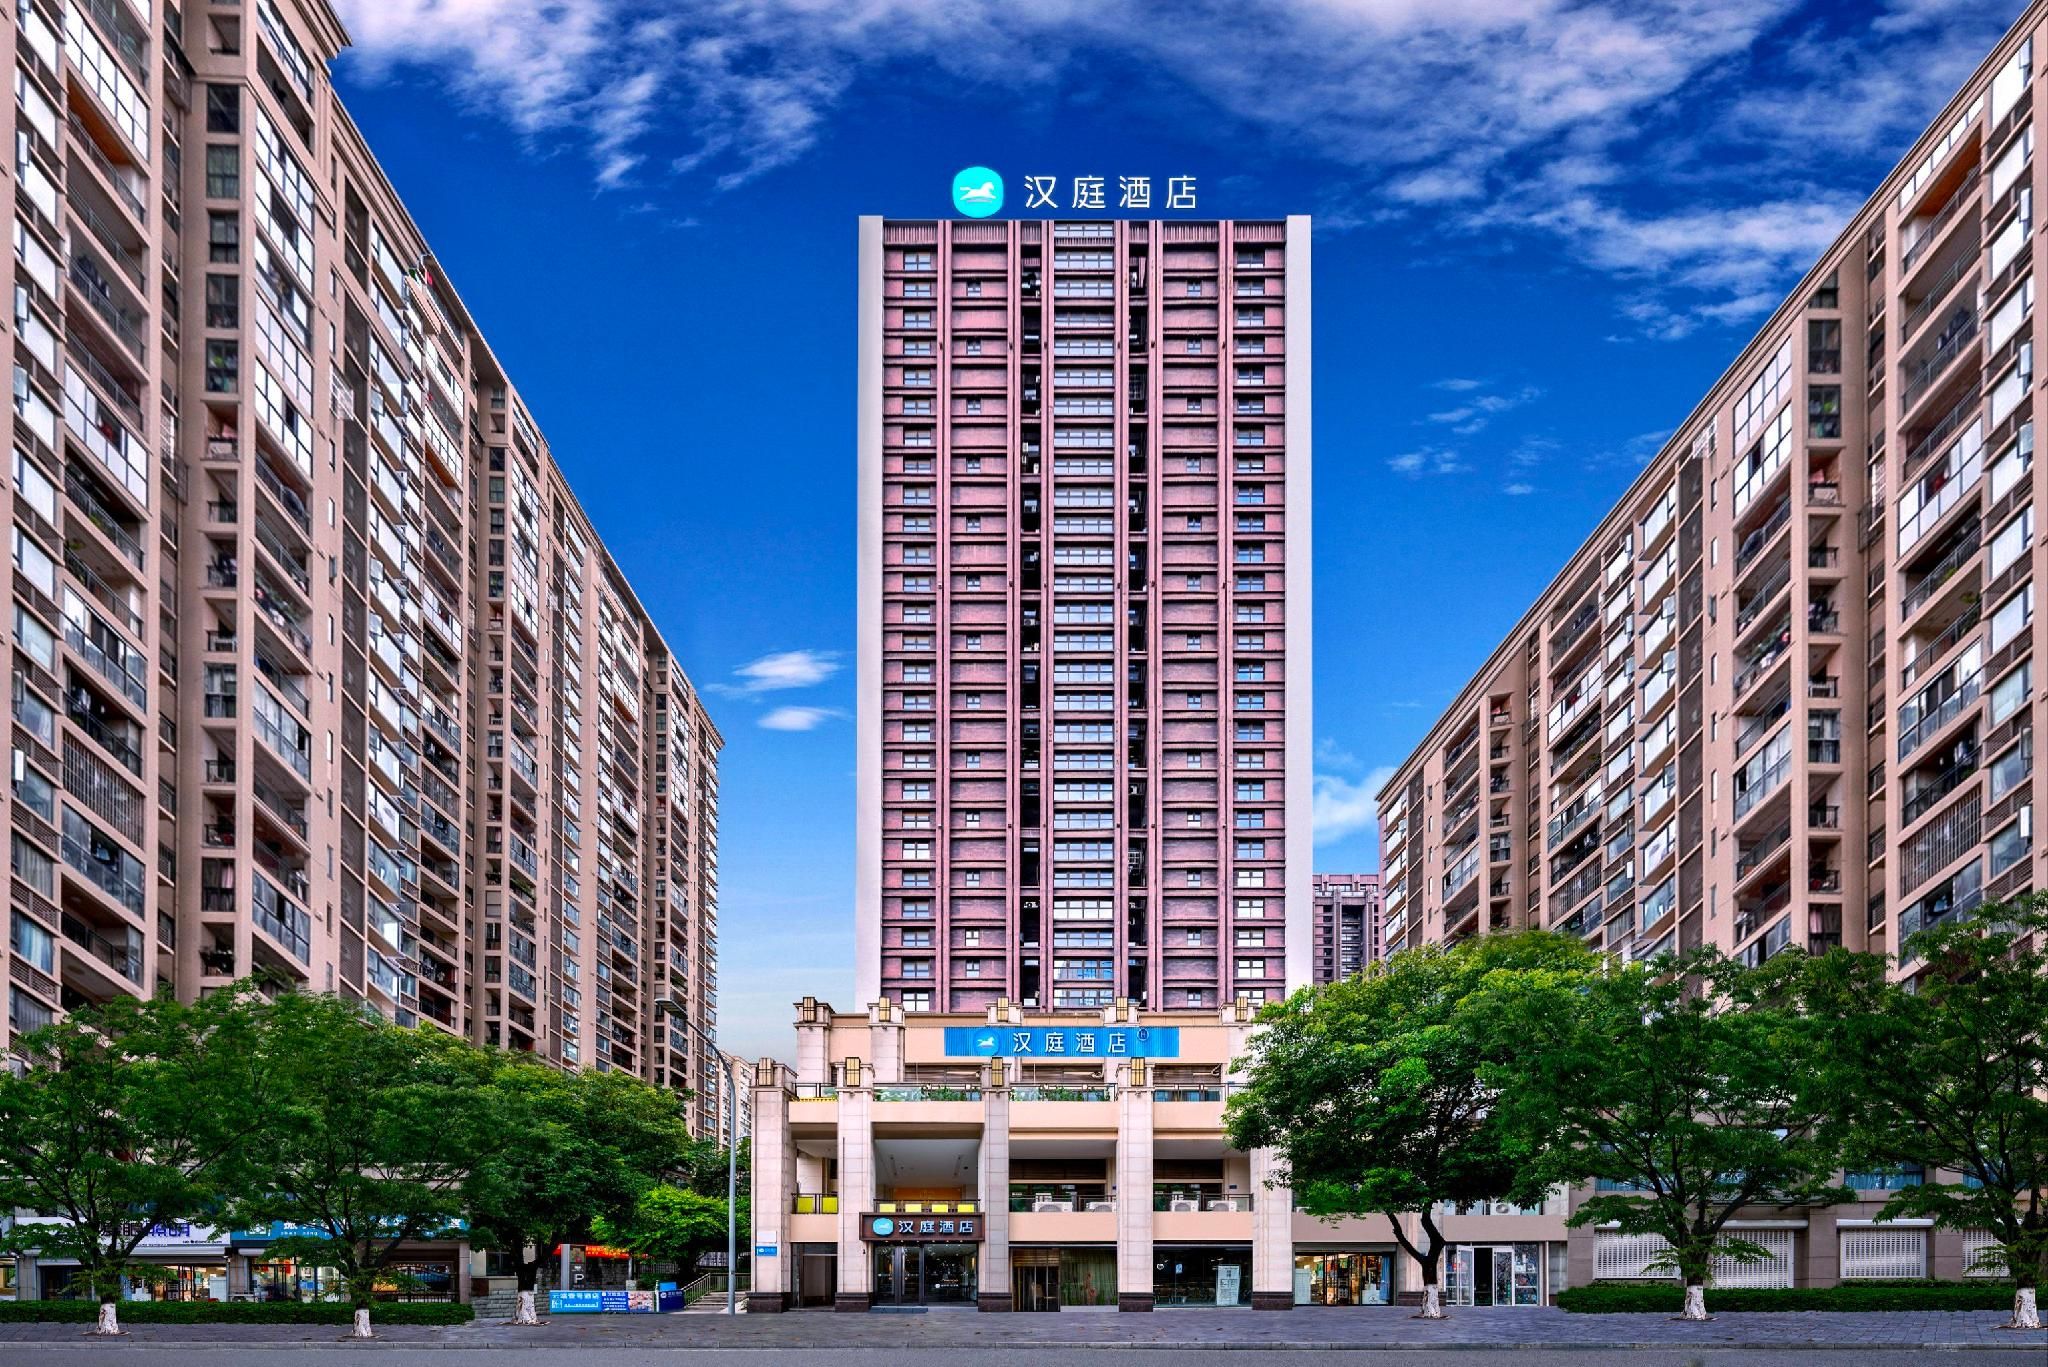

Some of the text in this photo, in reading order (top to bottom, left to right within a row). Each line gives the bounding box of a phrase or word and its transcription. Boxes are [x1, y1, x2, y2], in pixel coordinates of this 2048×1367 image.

[1024, 174, 1197, 209] 汉庭酒店
[1012, 1032, 1126, 1053] 汉庭酒店
[898, 1220, 974, 1233] 汉庭酒店
[574, 1273, 585, 1284] P
